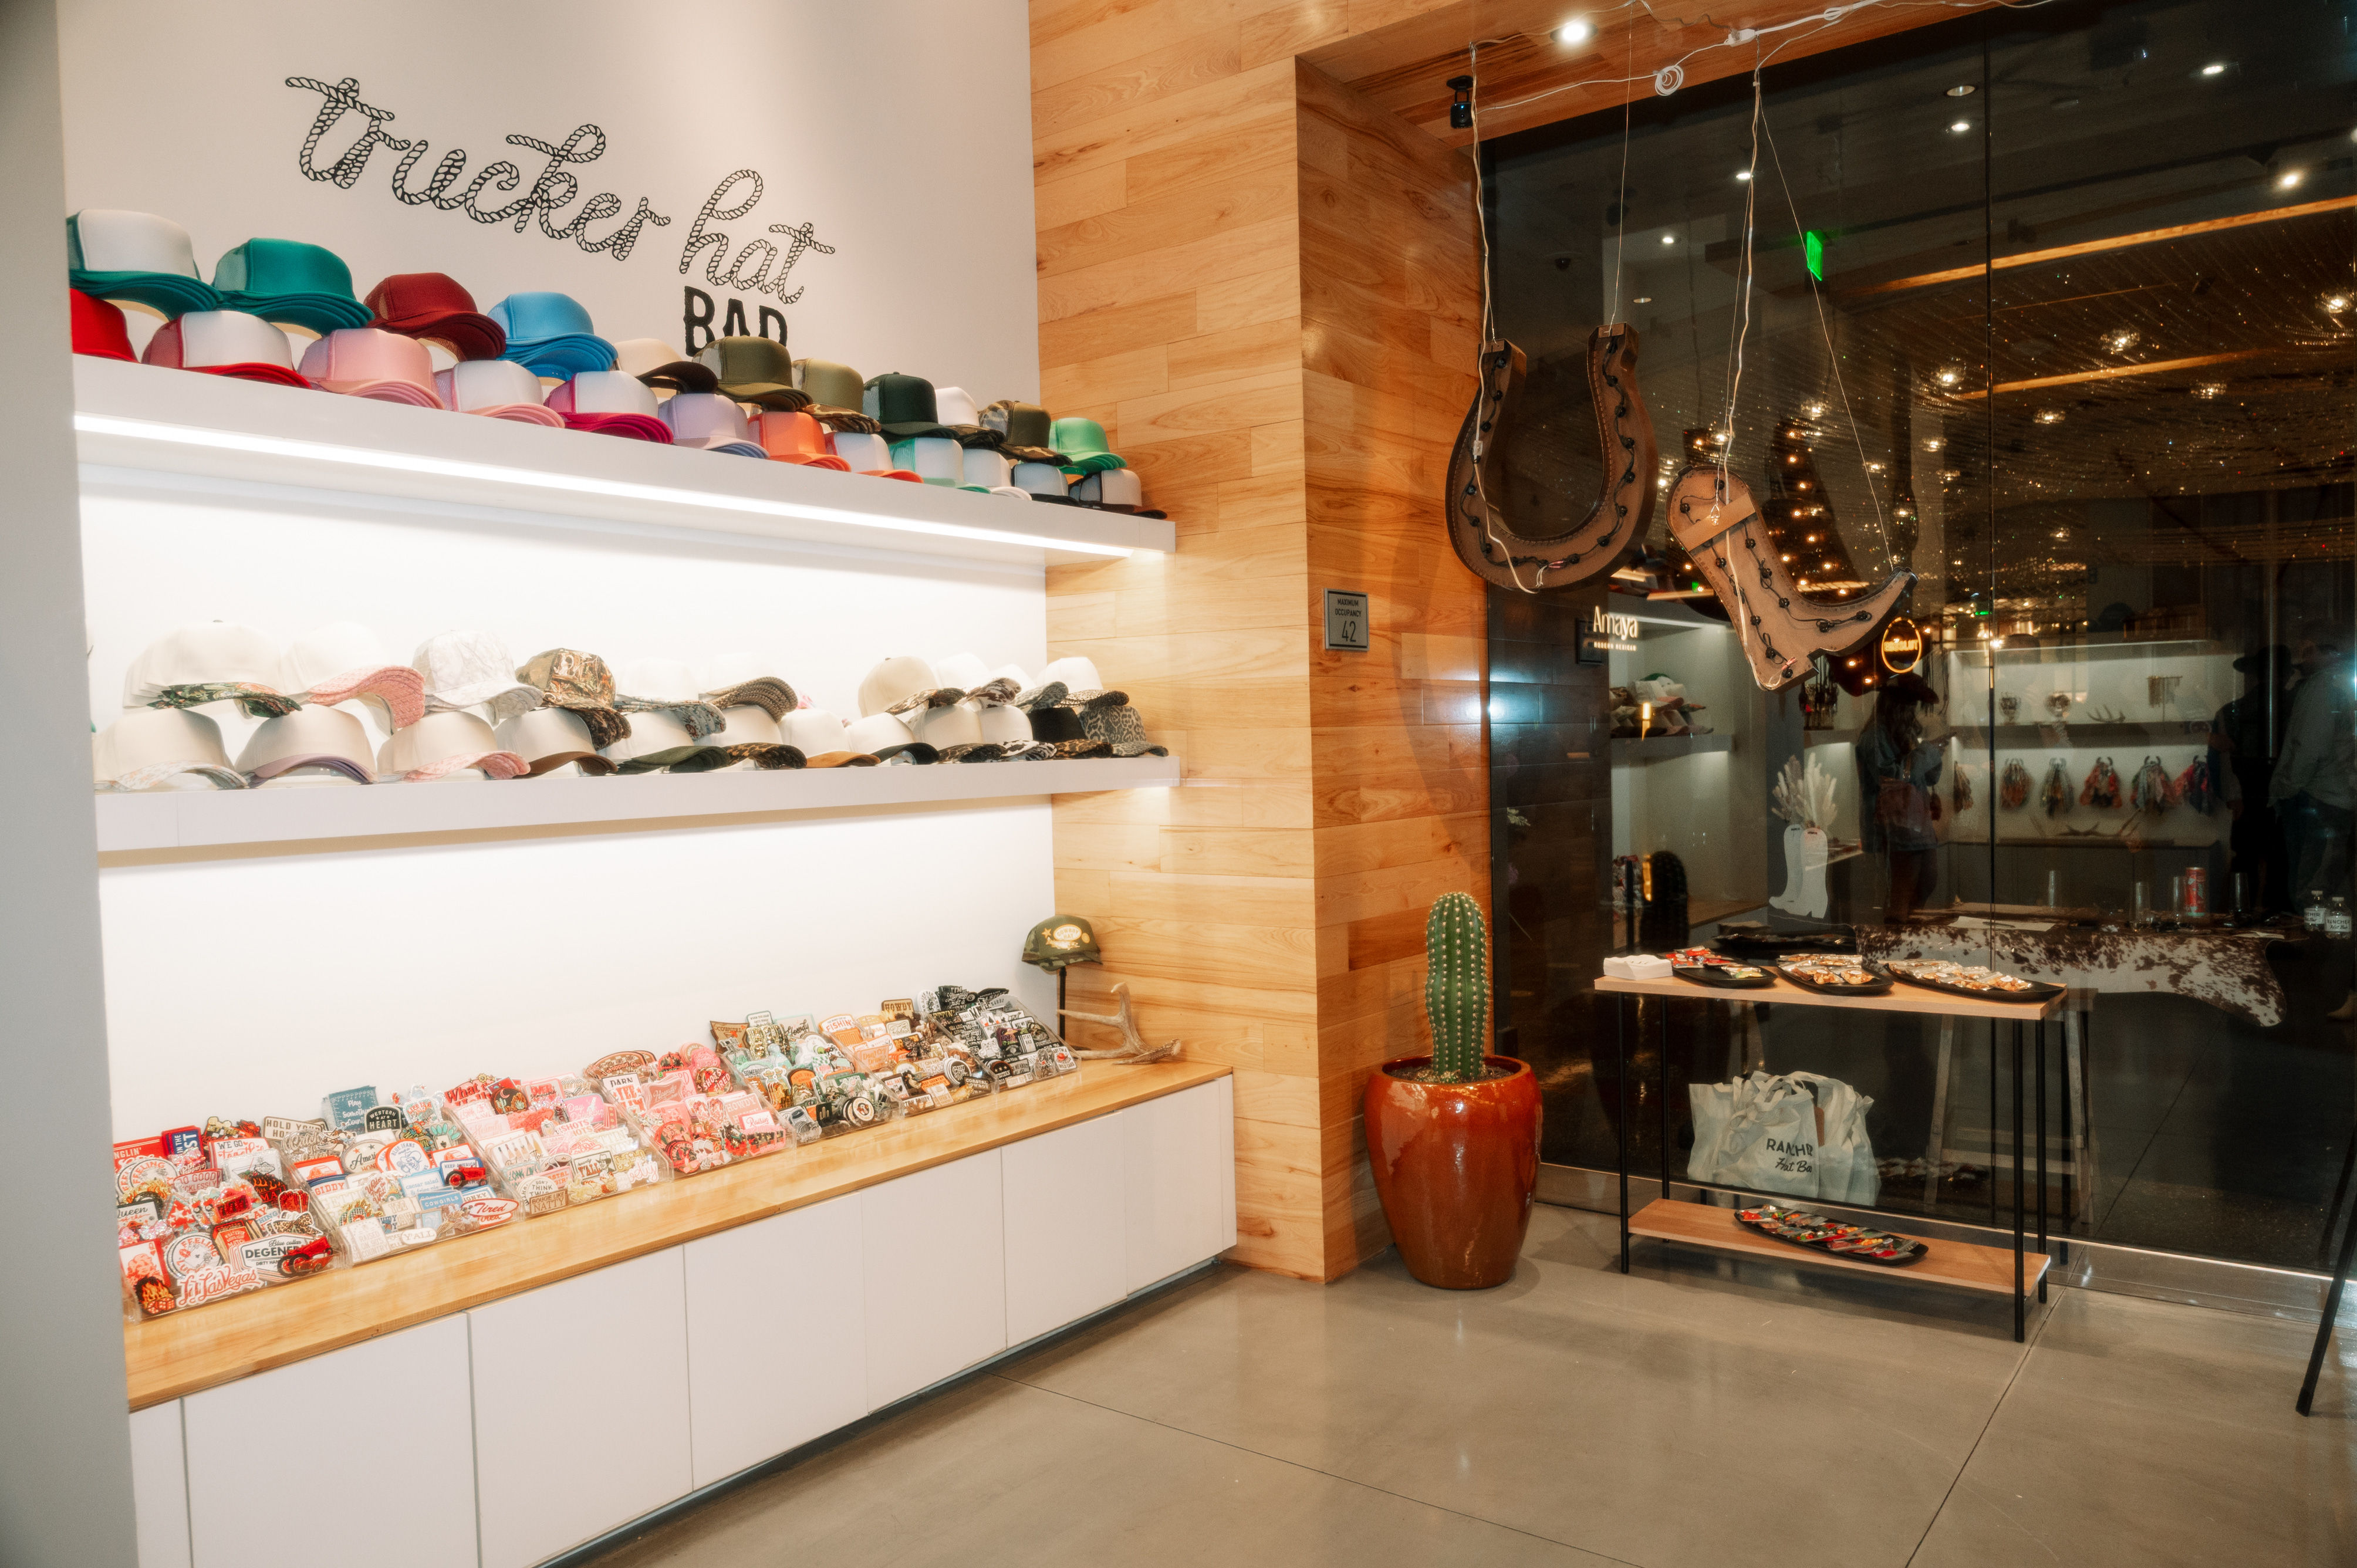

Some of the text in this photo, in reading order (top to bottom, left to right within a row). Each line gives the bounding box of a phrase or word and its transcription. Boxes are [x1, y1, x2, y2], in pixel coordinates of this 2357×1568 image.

[285, 77, 836, 304] trucker hat
[1335, 609, 1362, 617] OCCUPANCY
[1593, 605, 1639, 641] Amaya
[1342, 620, 1356, 642] 42
[1593, 641, 1637, 651] MODERN MEXICAN
[1056, 928, 1079, 937] COWBOY
[884, 1002, 911, 1012] HOWDY
[610, 1077, 634, 1087] DARN
[703, 1069, 722, 1090] SHOTS
[445, 1081, 479, 1104] What
[347, 1100, 362, 1109] Play
[726, 1097, 757, 1113] HOWDY
[369, 1110, 396, 1119] WESTERN
[266, 1119, 291, 1130] HOLD
[369, 1119, 397, 1130] HEART
[174, 1134, 183, 1146] THE
[217, 1141, 232, 1150] WE
[350, 1153, 376, 1170] Ameri
[1775, 1157, 1812, 1173] Hat Ba
[192, 1172, 216, 1183] GOOD
[183, 1181, 217, 1192] CKLESSLY
[315, 1182, 345, 1196] GIDDY
[424, 1195, 459, 1207] COWGIRLS
[532, 1195, 552, 1204] BOUGIE
[533, 1198, 564, 1213] NATTY
[474, 1202, 508, 1214] Tired
[181, 1237, 219, 1257] FEELING
[268, 1239, 285, 1247] Blue
[245, 1245, 299, 1259] DEGEN
[218, 1265, 257, 1290] Vegas
